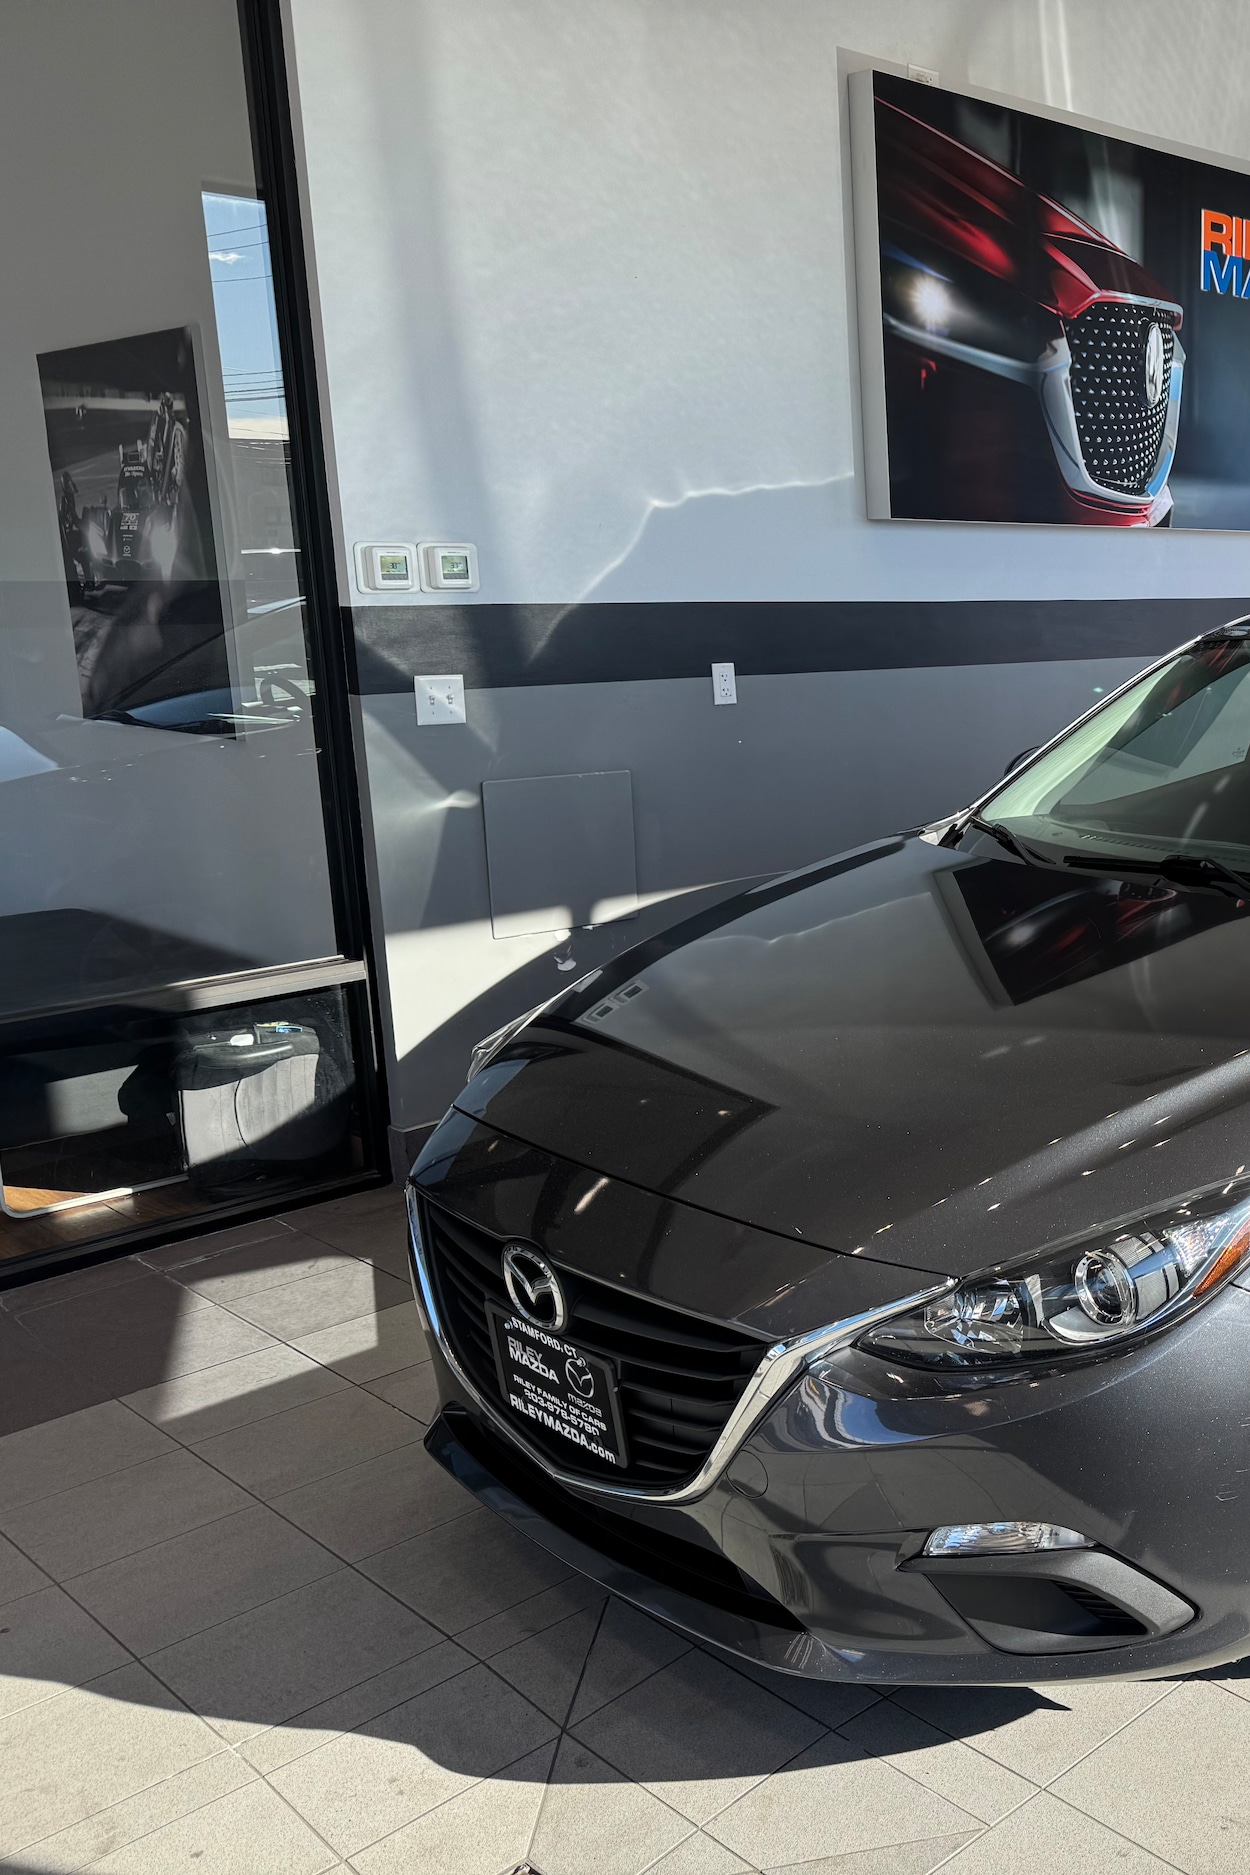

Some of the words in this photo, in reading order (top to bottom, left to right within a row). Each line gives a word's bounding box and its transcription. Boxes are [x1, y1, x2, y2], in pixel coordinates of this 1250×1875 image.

[507, 1335, 543, 1362] RILEY
[508, 1346, 560, 1385] MAZDA
[563, 1344, 577, 1359] CT
[513, 1374, 536, 1392] RILEY
[536, 1387, 568, 1410] FAMILY
[568, 1404, 581, 1417] OF
[581, 1412, 607, 1432] CARS
[510, 1393, 616, 1465] RILEYMAZDA.com
